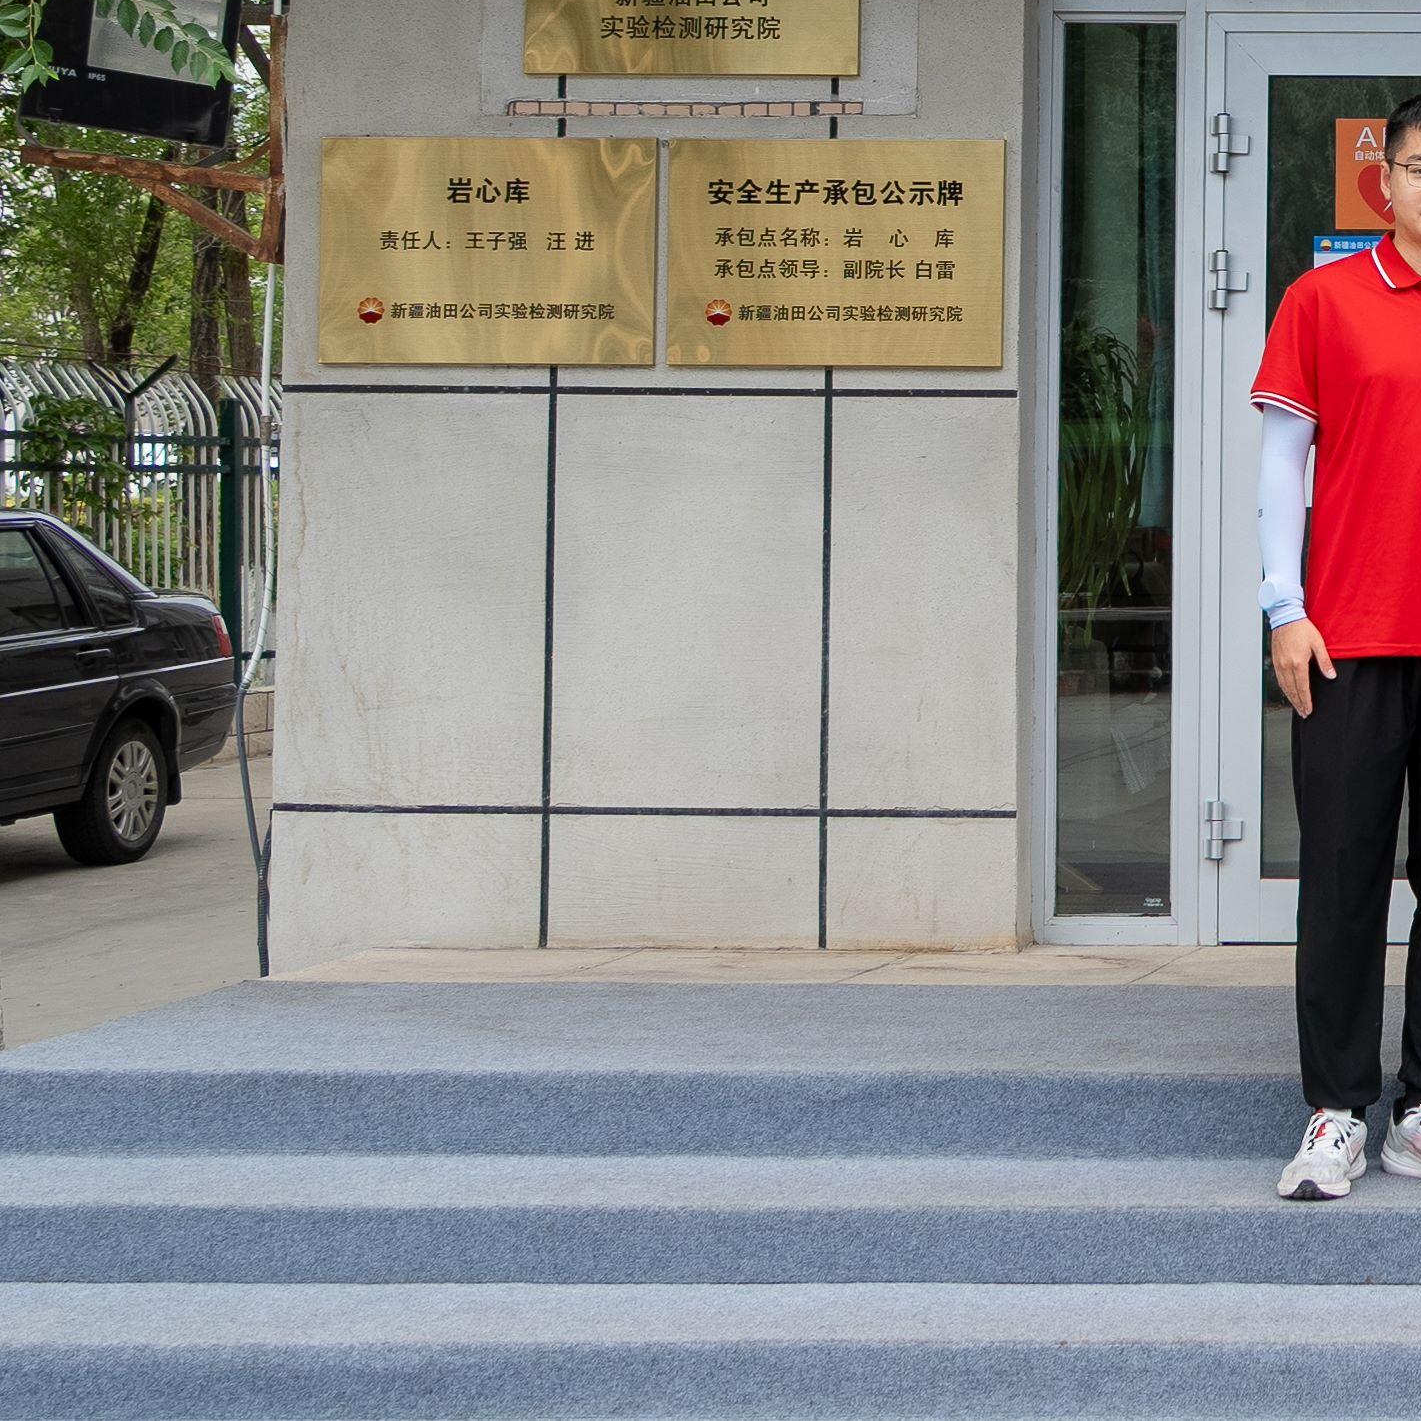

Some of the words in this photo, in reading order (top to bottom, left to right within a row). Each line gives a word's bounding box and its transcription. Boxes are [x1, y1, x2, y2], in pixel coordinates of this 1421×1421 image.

[600, 14, 781, 40] 实验检测研究院
[1356, 126, 1387, 148] A
[446, 176, 530, 205] 岩心库
[706, 178, 965, 208] 安全生产承包公示牌
[390, 301, 616, 321] 新疆油田公司实验检测研究院
[737, 303, 963, 323] 新疆油田公司实验检测研究院
